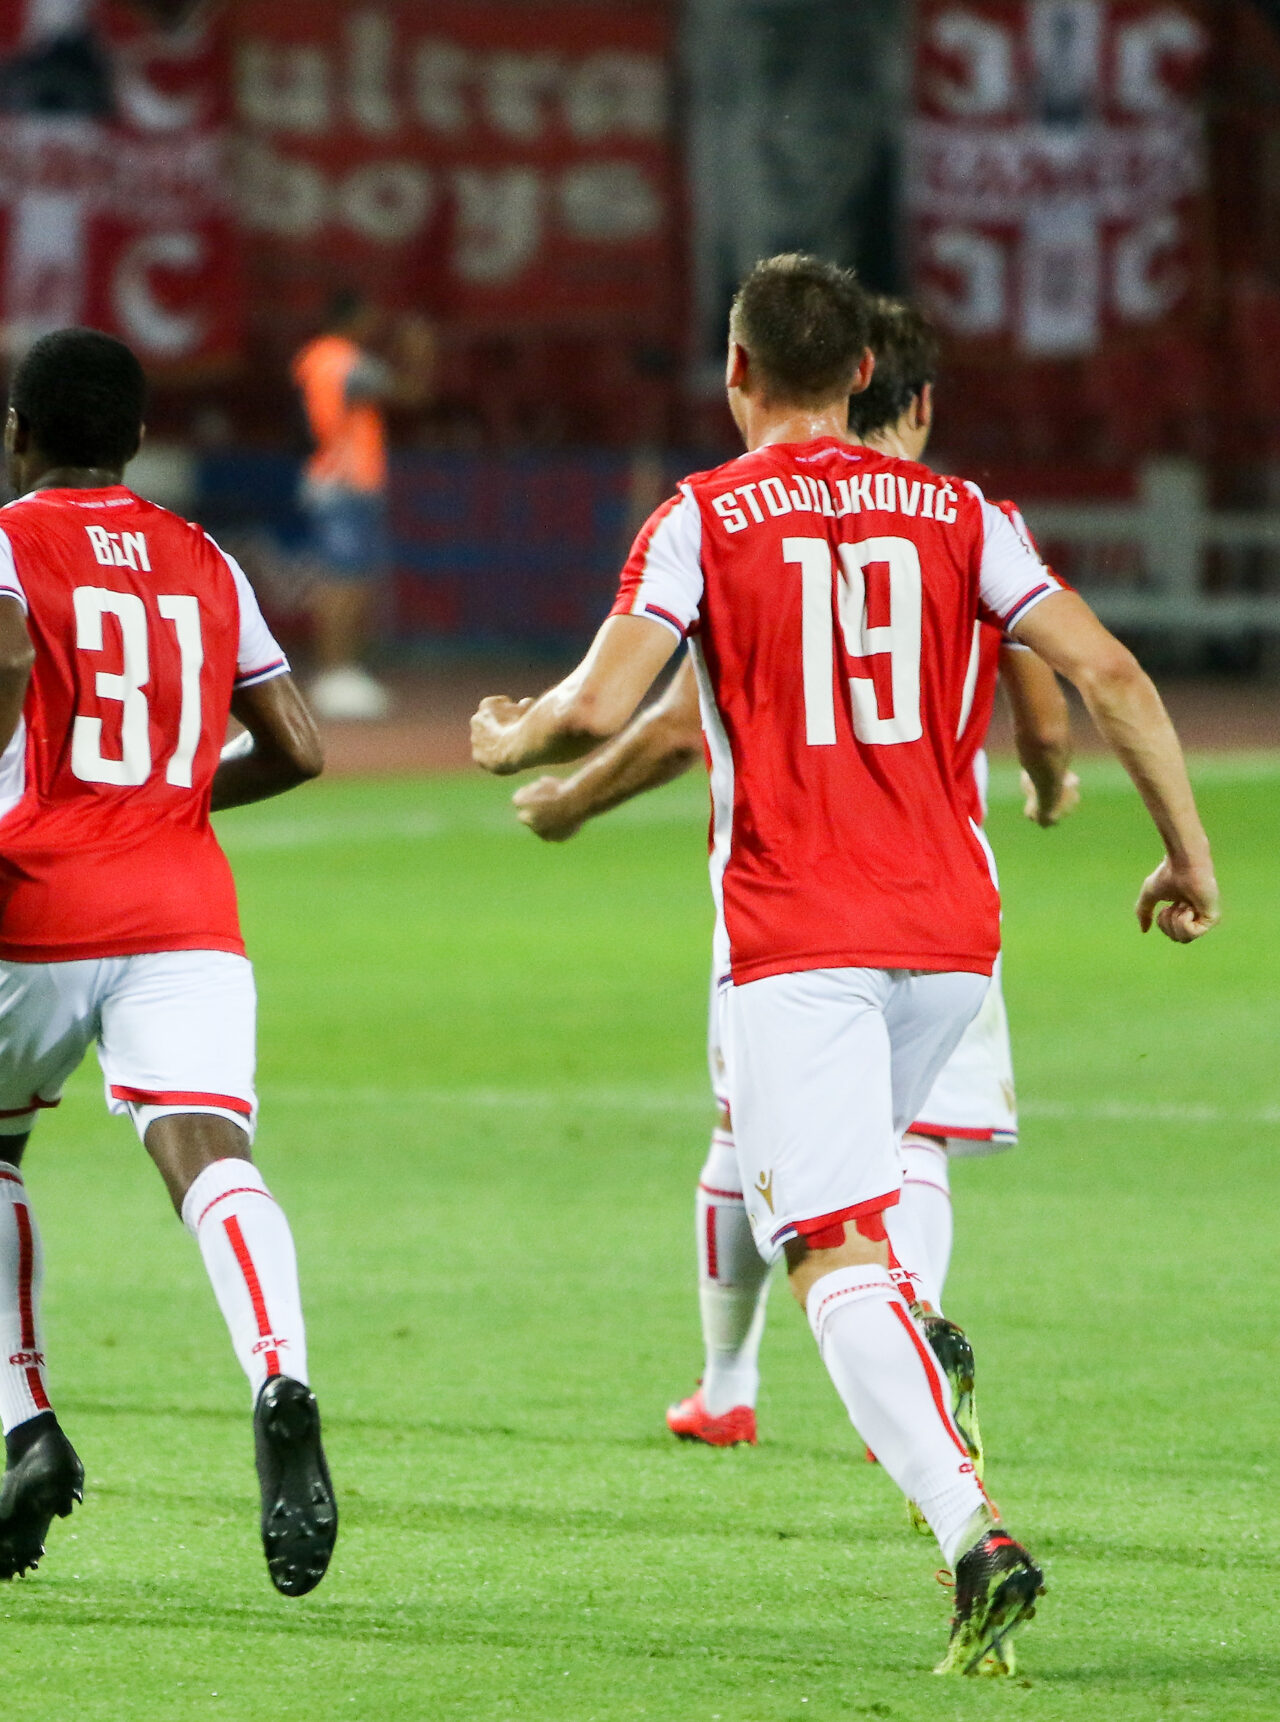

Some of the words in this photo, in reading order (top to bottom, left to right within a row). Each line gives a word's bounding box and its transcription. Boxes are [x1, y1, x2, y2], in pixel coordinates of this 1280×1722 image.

[237, 12, 668, 140] ultra
[71, 586, 204, 788] 31
[782, 536, 923, 746] 19
